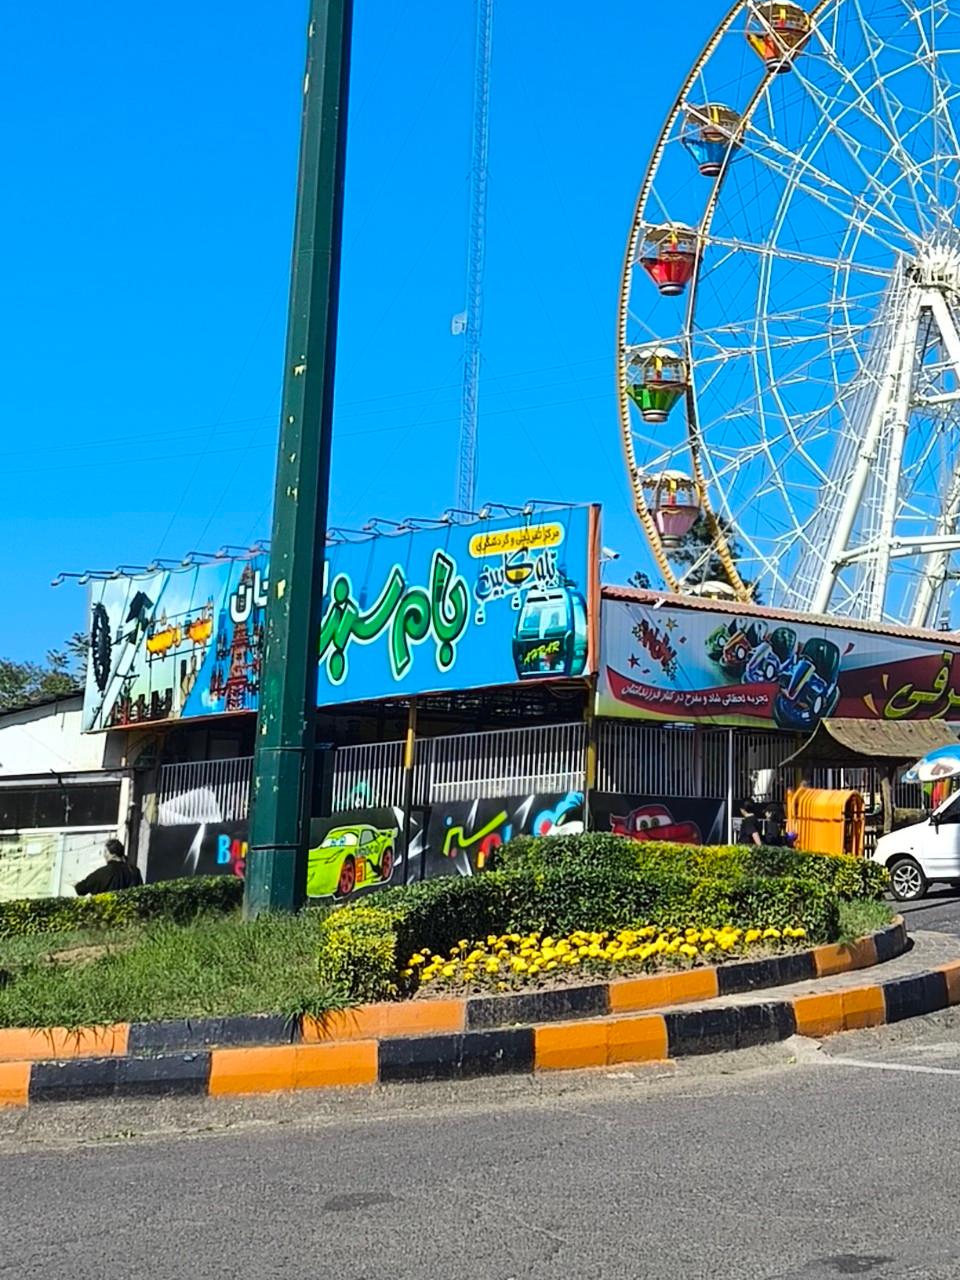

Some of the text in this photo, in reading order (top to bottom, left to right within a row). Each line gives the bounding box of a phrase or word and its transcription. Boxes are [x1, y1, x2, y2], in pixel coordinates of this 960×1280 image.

[390, 550, 469, 679] بام
[722, 692, 746, 706] لحظاتی
[747, 693, 769, 705] تجربه
